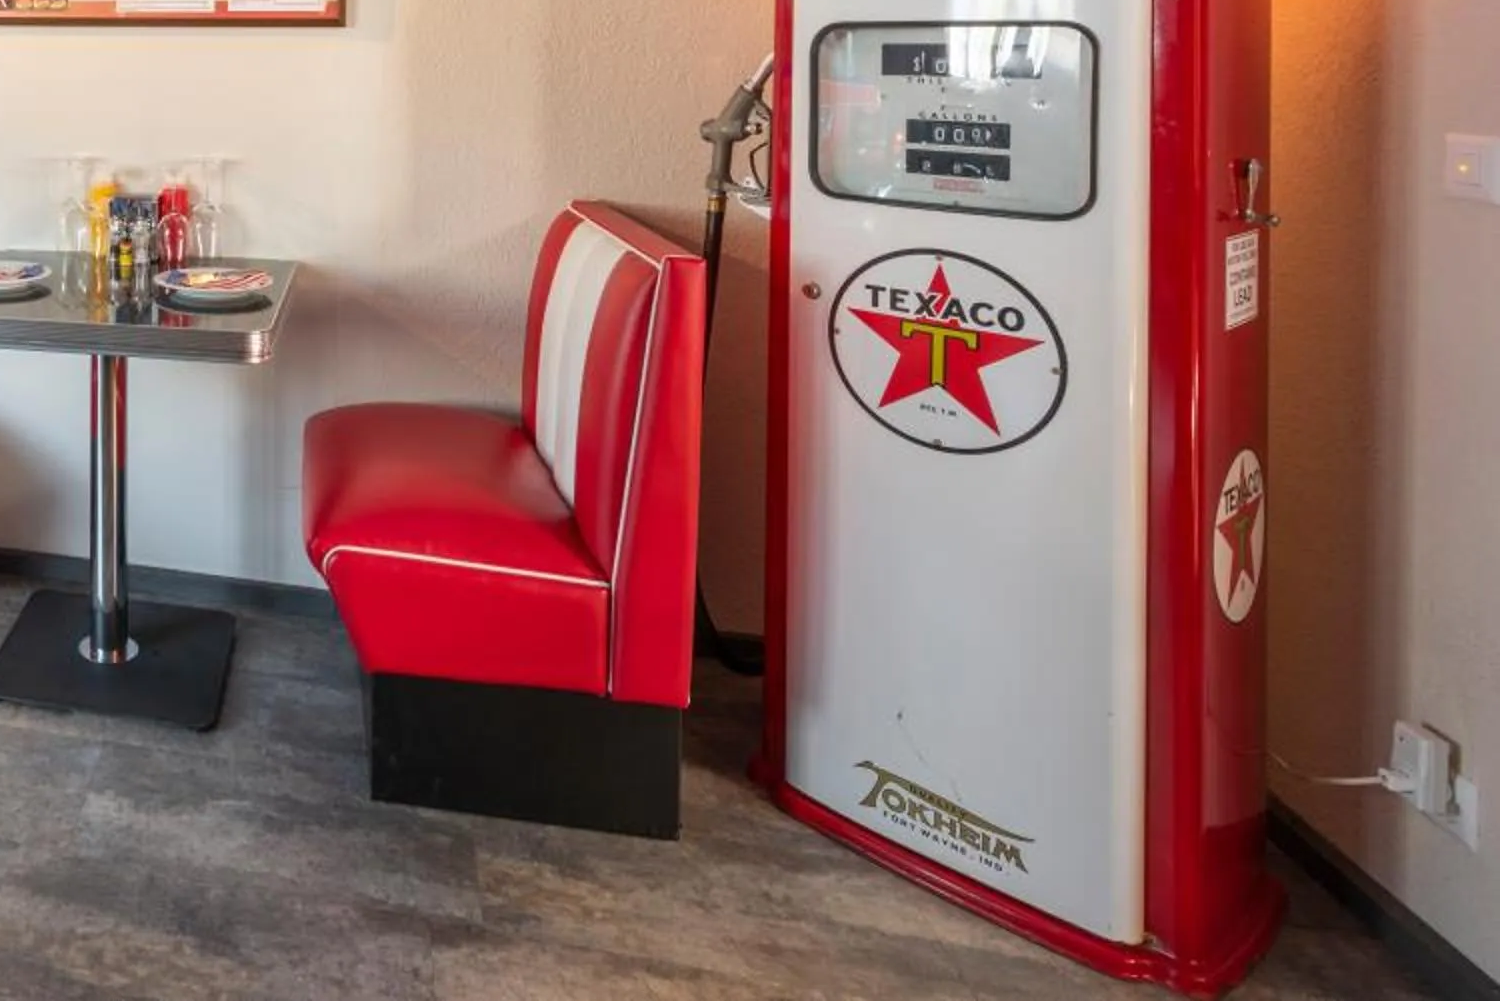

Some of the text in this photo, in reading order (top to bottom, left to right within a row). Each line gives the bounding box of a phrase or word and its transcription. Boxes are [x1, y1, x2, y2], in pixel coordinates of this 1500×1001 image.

[865, 284, 1025, 332] TEXACO
[901, 318, 980, 387] T
[1224, 469, 1261, 515] TEXACO
[853, 760, 1035, 874] TOKHEIM
[883, 810, 916, 832] FORT
